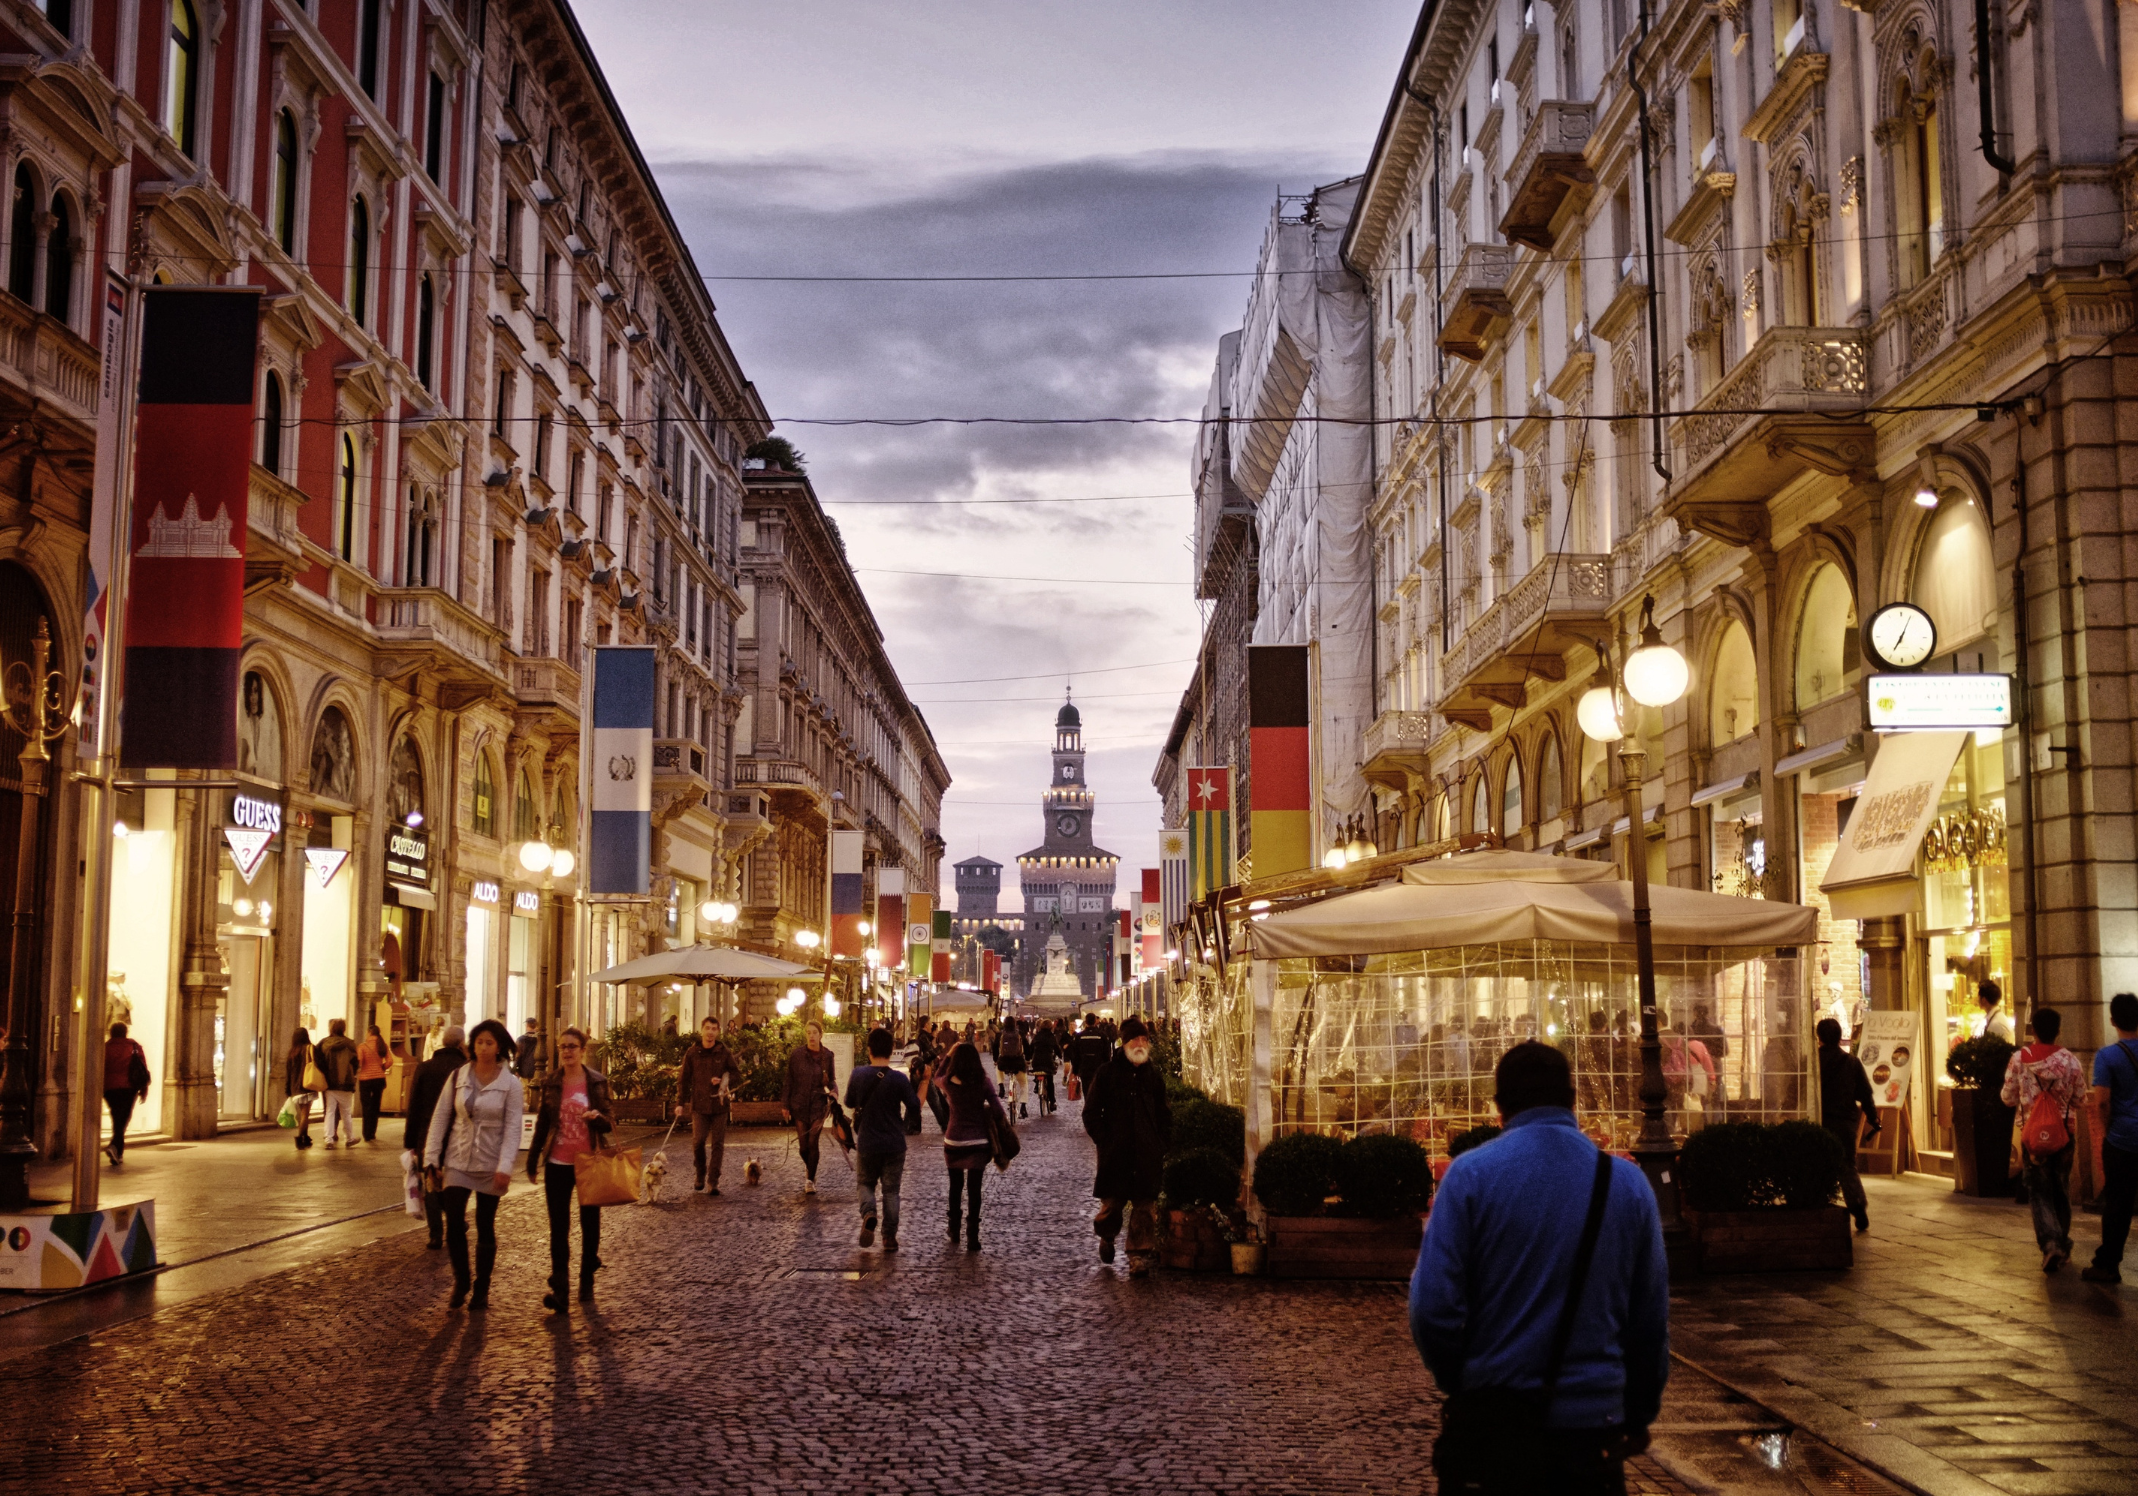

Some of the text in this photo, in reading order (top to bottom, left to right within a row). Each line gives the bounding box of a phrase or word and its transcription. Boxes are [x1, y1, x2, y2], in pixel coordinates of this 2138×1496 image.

[104, 319, 114, 398] cambogia
[233, 797, 281, 832] GUESS
[231, 833, 264, 843] GUESS
[390, 835, 425, 860] CASTELLO
[310, 852, 340, 861] GUESS
[474, 882, 498, 903] ALDO
[516, 891, 538, 910] ALDO
